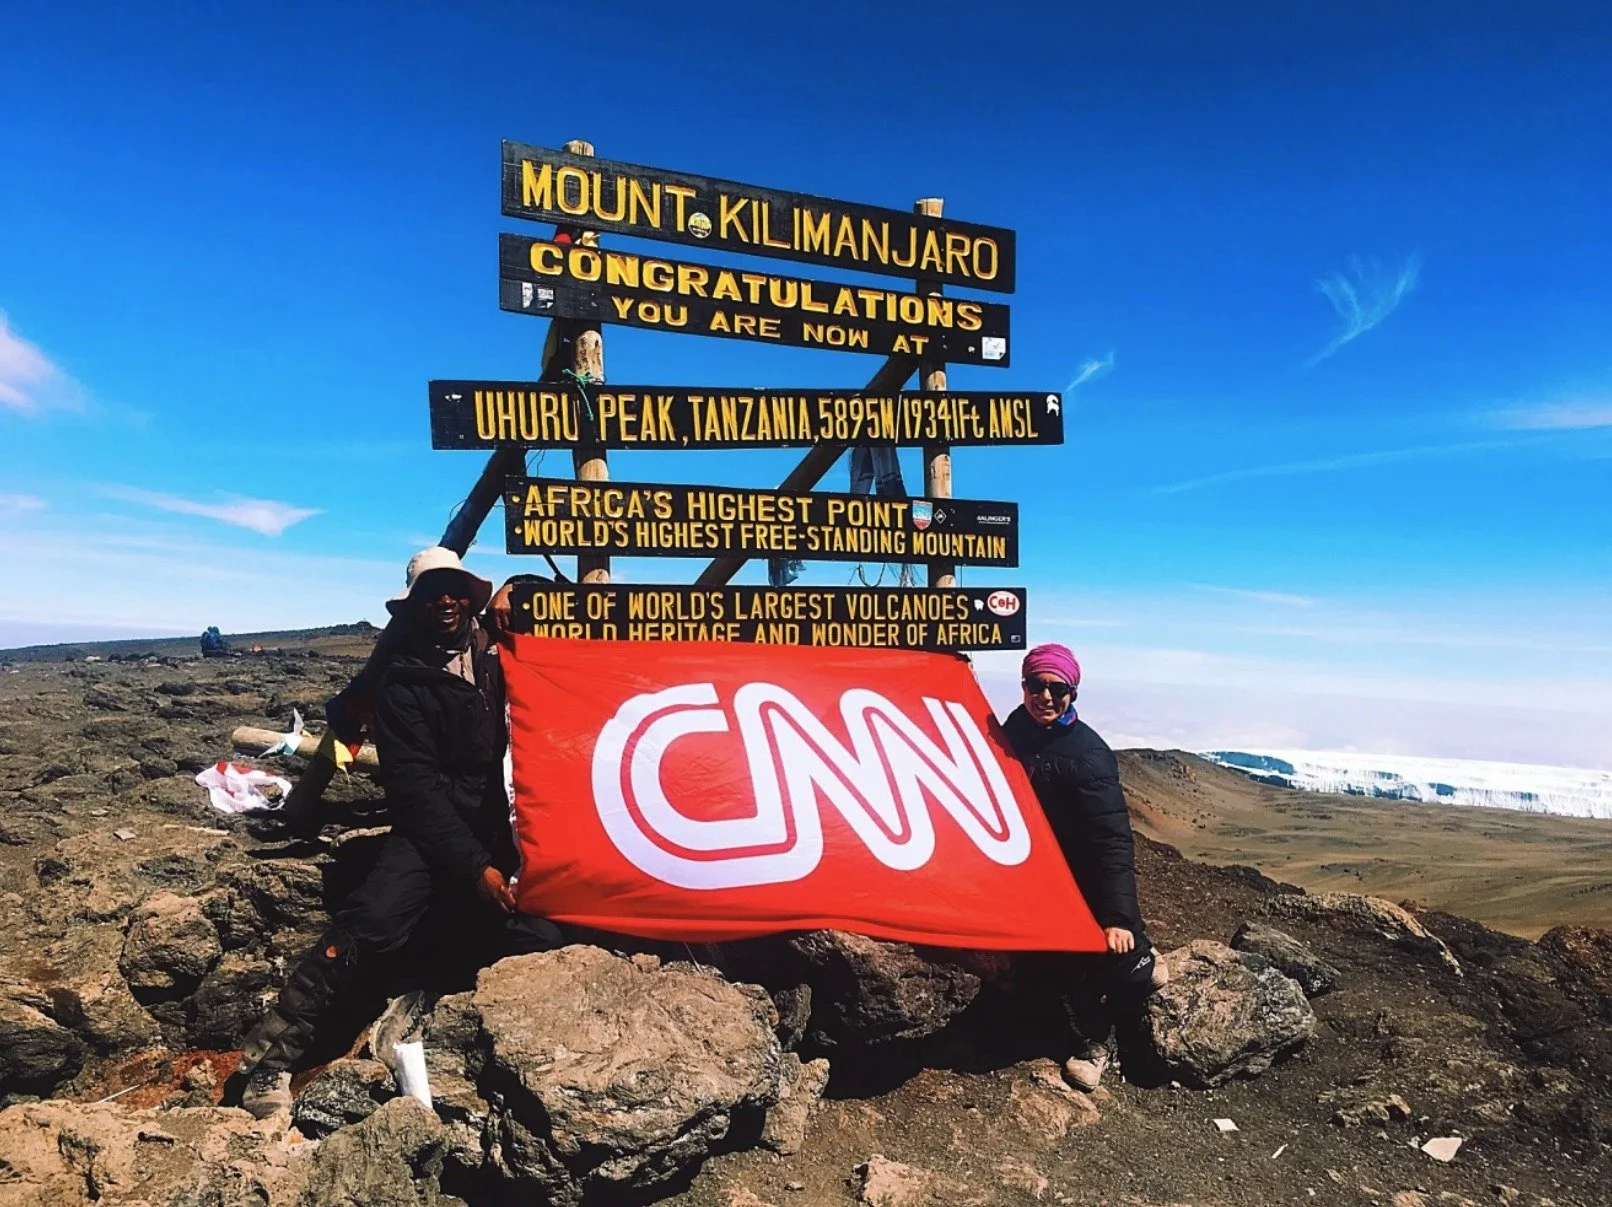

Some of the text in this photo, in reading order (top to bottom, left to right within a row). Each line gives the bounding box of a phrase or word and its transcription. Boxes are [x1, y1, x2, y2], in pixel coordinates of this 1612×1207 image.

[521, 158, 999, 281] MOUNT KILIMANJARO
[529, 241, 983, 332] CONGRATULATIONS
[611, 295, 930, 355] YOU ARE NOW AT
[473, 390, 580, 441] UHURU
[989, 398, 1039, 439] AMSL
[523, 484, 909, 529] AFRICA'S HIGHEST POINT
[523, 519, 1006, 559] WORLD'S HIGHEST FREE-STANDING MOUNTAIN
[532, 591, 969, 621] ONE OF WORLD'S LARGEST VOLCANOES
[628, 622, 741, 643] HERITAGE
[754, 622, 800, 645] AND
[812, 623, 900, 647] WONDER
[906, 623, 929, 646] OF
[936, 623, 1002, 645] AFRICA
[591, 681, 1032, 890] CNN
